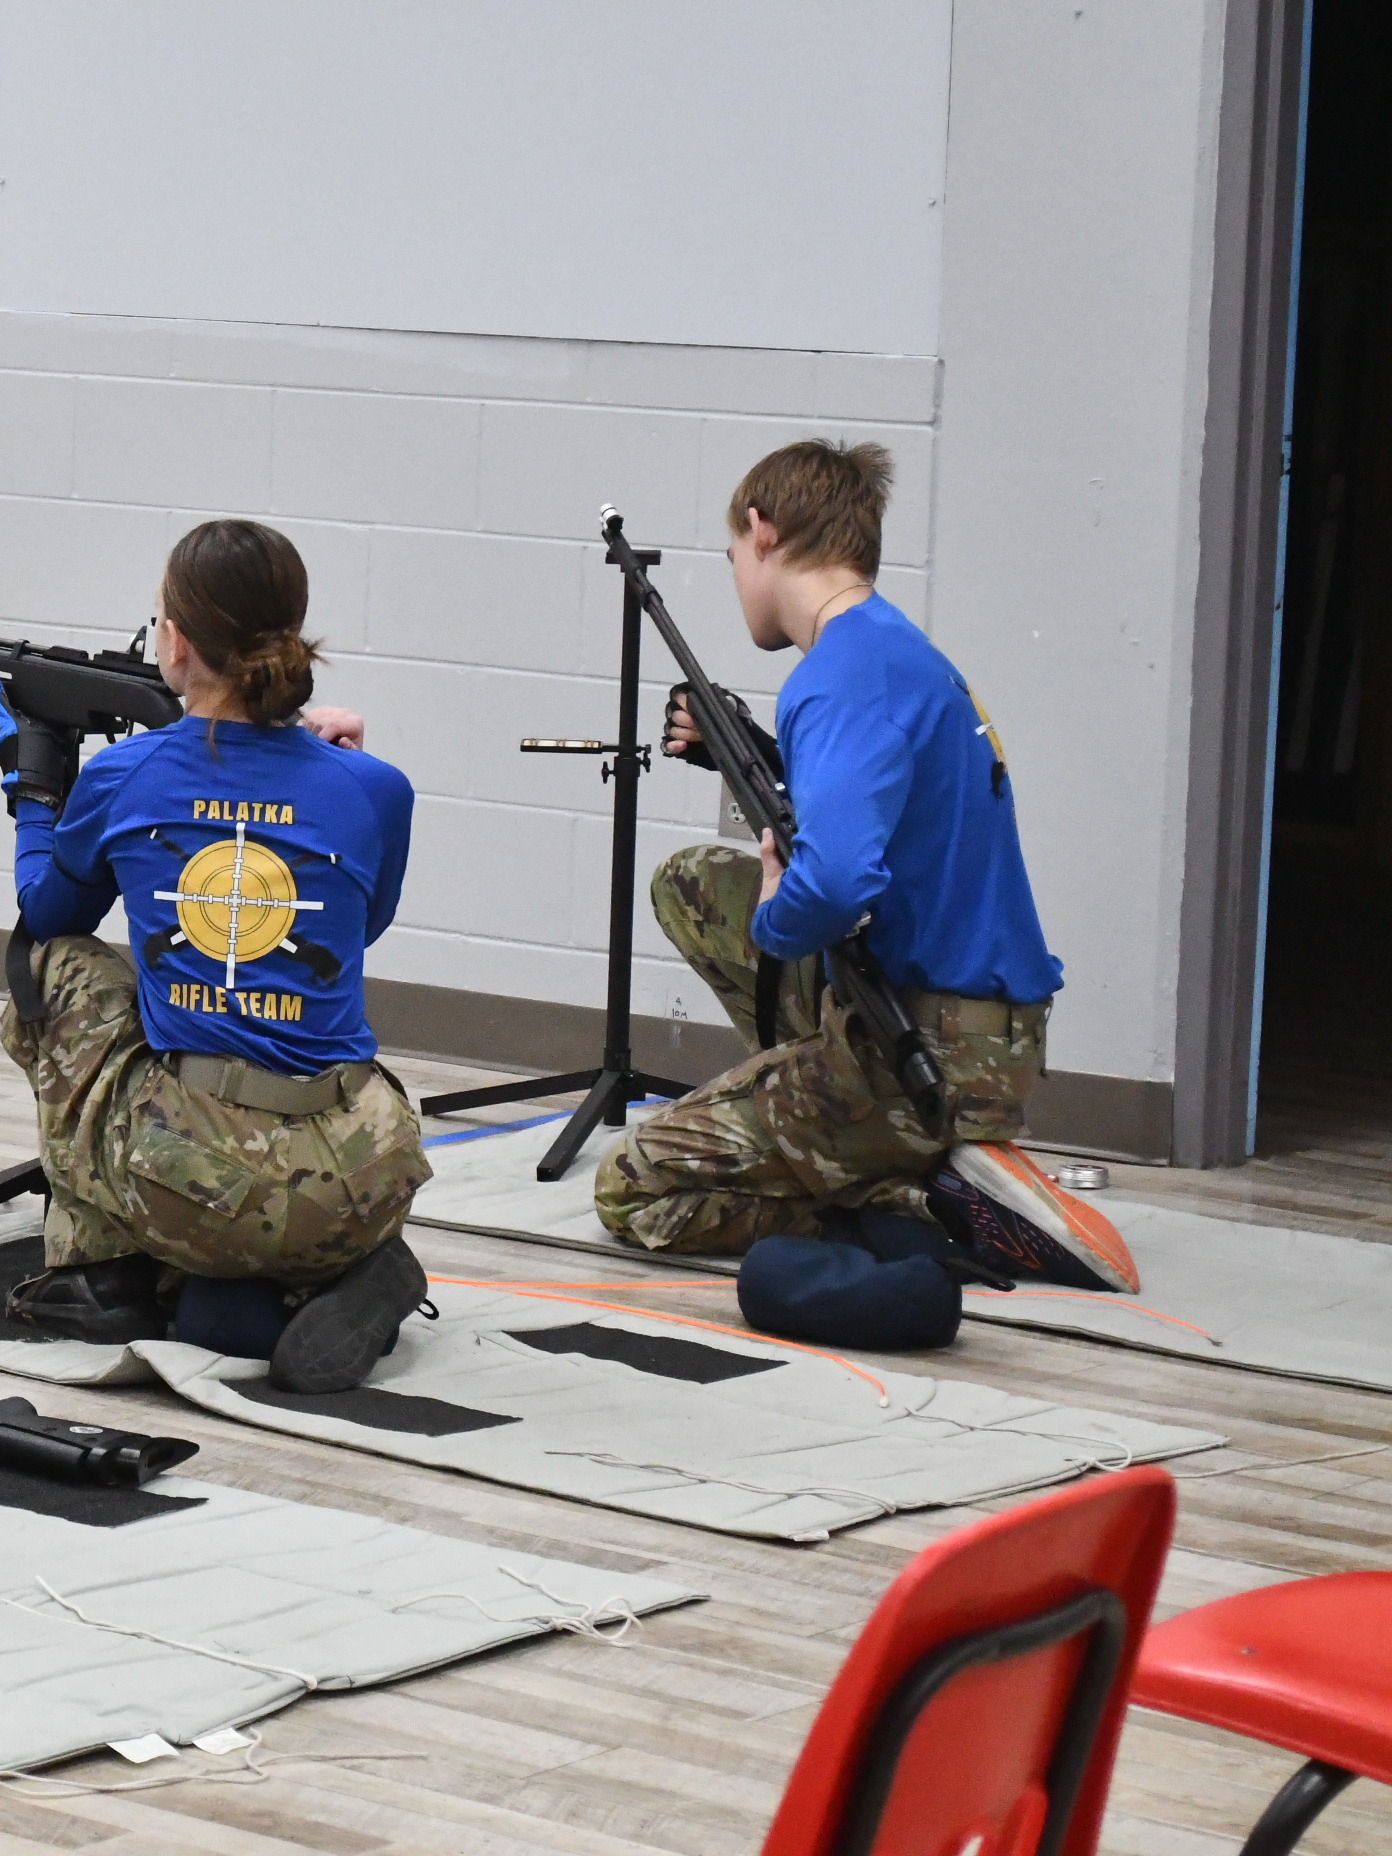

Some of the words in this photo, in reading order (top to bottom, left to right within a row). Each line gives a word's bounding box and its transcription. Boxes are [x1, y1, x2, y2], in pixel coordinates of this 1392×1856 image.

[193, 799, 294, 825] PALATKA
[169, 983, 228, 1014] RIFLE
[236, 991, 303, 1021] TEAM
